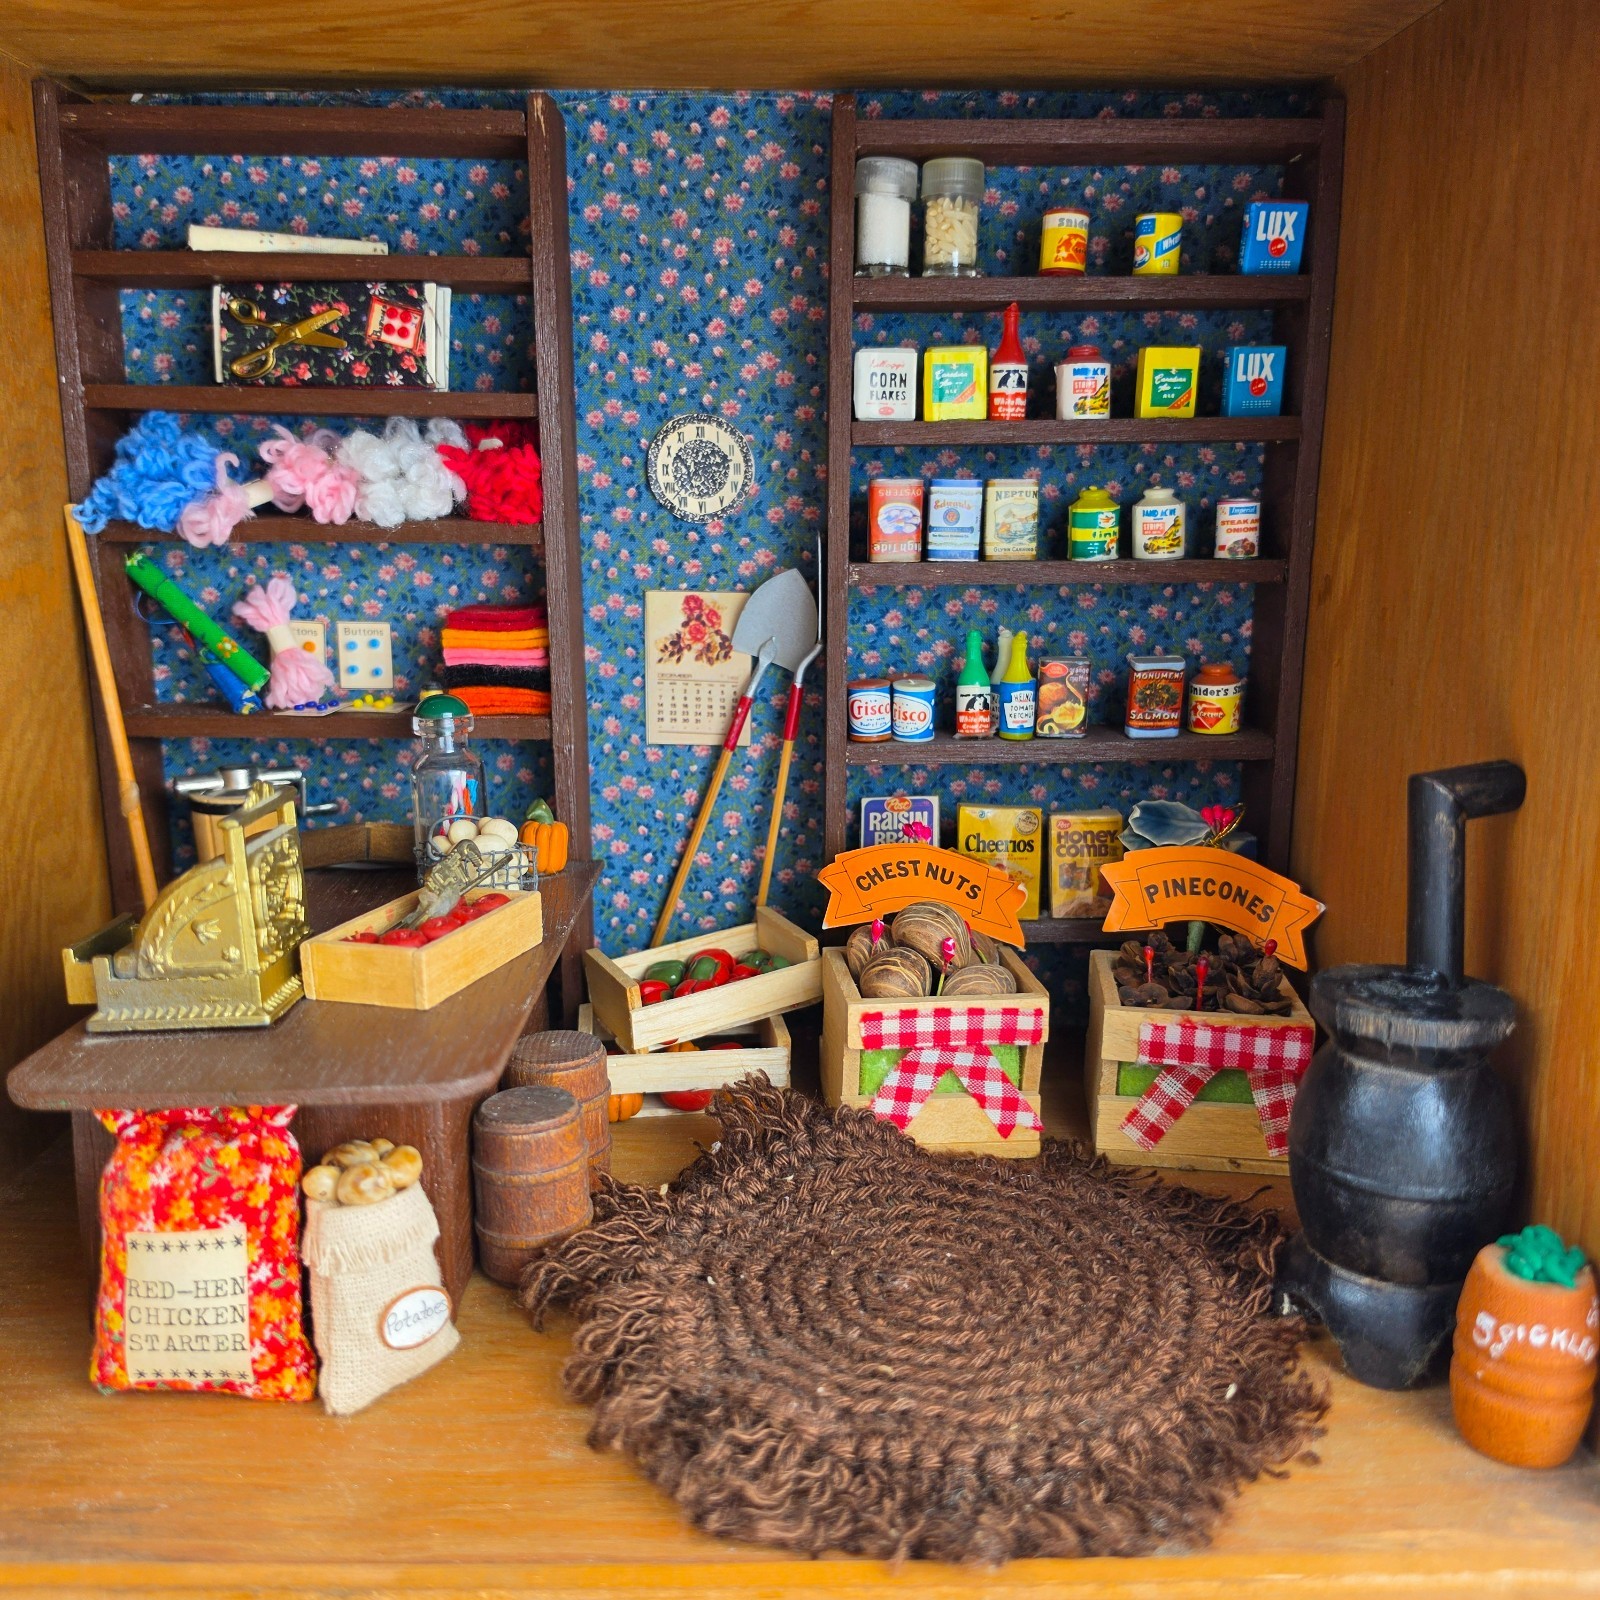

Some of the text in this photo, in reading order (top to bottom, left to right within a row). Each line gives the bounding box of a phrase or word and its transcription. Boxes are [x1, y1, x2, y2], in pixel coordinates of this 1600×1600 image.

[1256, 211, 1298, 241] LUX
[1237, 353, 1275, 382] LUX
[870, 371, 907, 388] CORN
[870, 390, 907, 401] FLAKES
[343, 627, 384, 636] Buttons
[1133, 672, 1184, 681] MONUMENT
[1014, 693, 1032, 702] HEINZ
[850, 699, 891, 720] Crisco
[893, 702, 927, 722] risco
[1130, 710, 1179, 720] SALMON
[887, 798, 910, 811] Post
[1056, 821, 1070, 829] Post
[965, 833, 1035, 853] Cheerios
[855, 860, 982, 900] CHESTNUTS
[1144, 876, 1275, 923] PINECONES
[127, 1275, 247, 1299] RED-HEN
[128, 1304, 247, 1326] CHICKEN
[387, 1299, 449, 1335] Potatoes
[129, 1333, 248, 1352] STARTER
